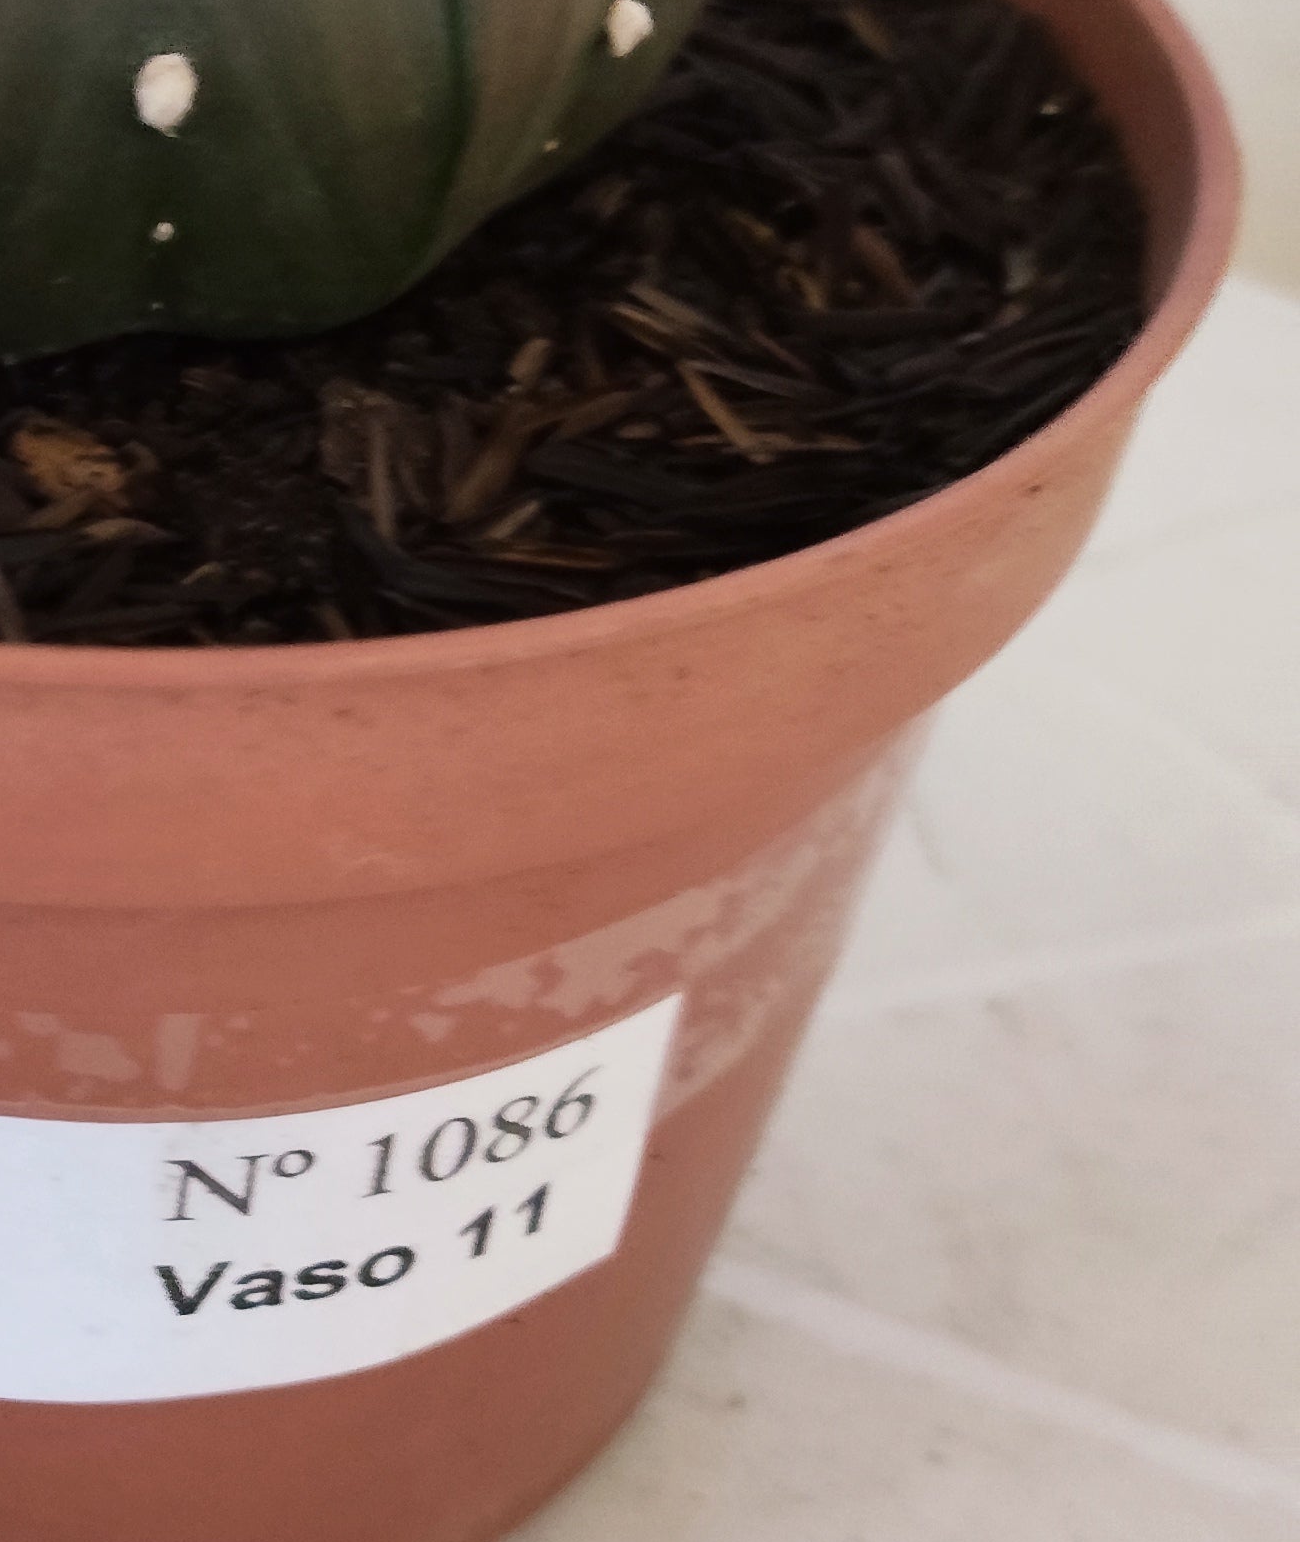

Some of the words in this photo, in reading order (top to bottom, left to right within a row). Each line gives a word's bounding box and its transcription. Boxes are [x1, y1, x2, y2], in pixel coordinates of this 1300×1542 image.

[360, 1065, 604, 1199] 1086
[154, 1245, 417, 1318] Vaso
[459, 1180, 553, 1258] 11
